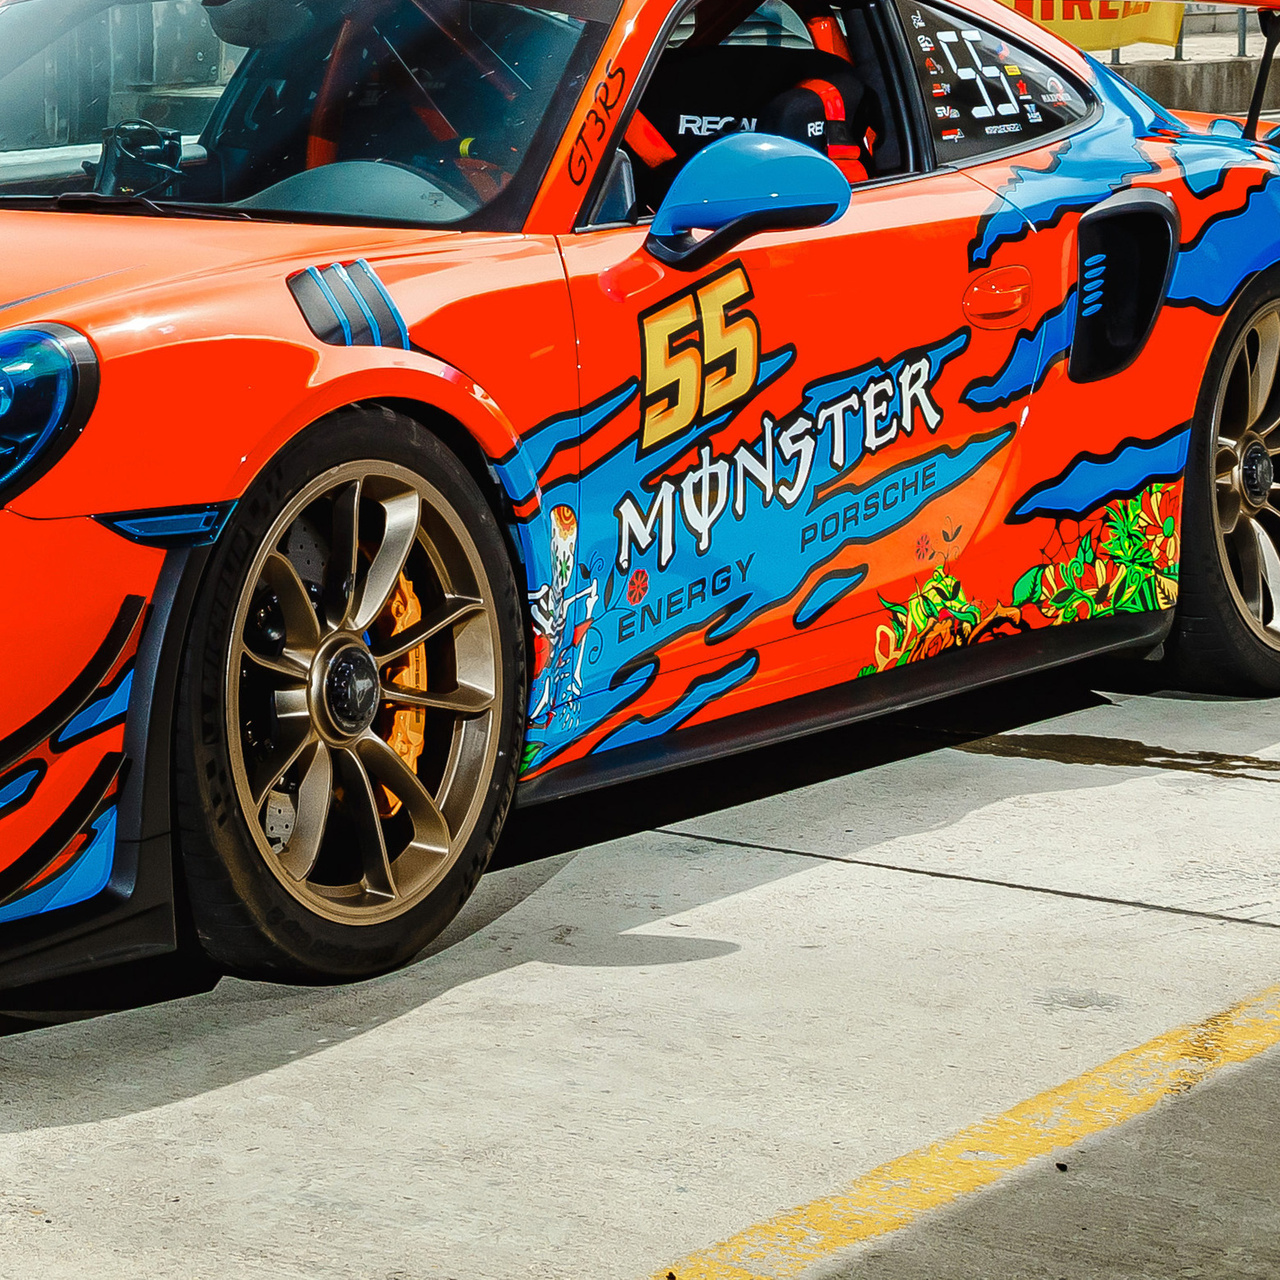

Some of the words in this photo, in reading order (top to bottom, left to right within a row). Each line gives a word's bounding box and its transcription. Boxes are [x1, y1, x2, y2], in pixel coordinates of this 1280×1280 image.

[936, 30, 1020, 118] 55
[568, 58, 626, 186] GT3RS
[639, 263, 760, 454] 55
[800, 461, 938, 553] PORSCHE
[617, 552, 757, 645] ENERGY
